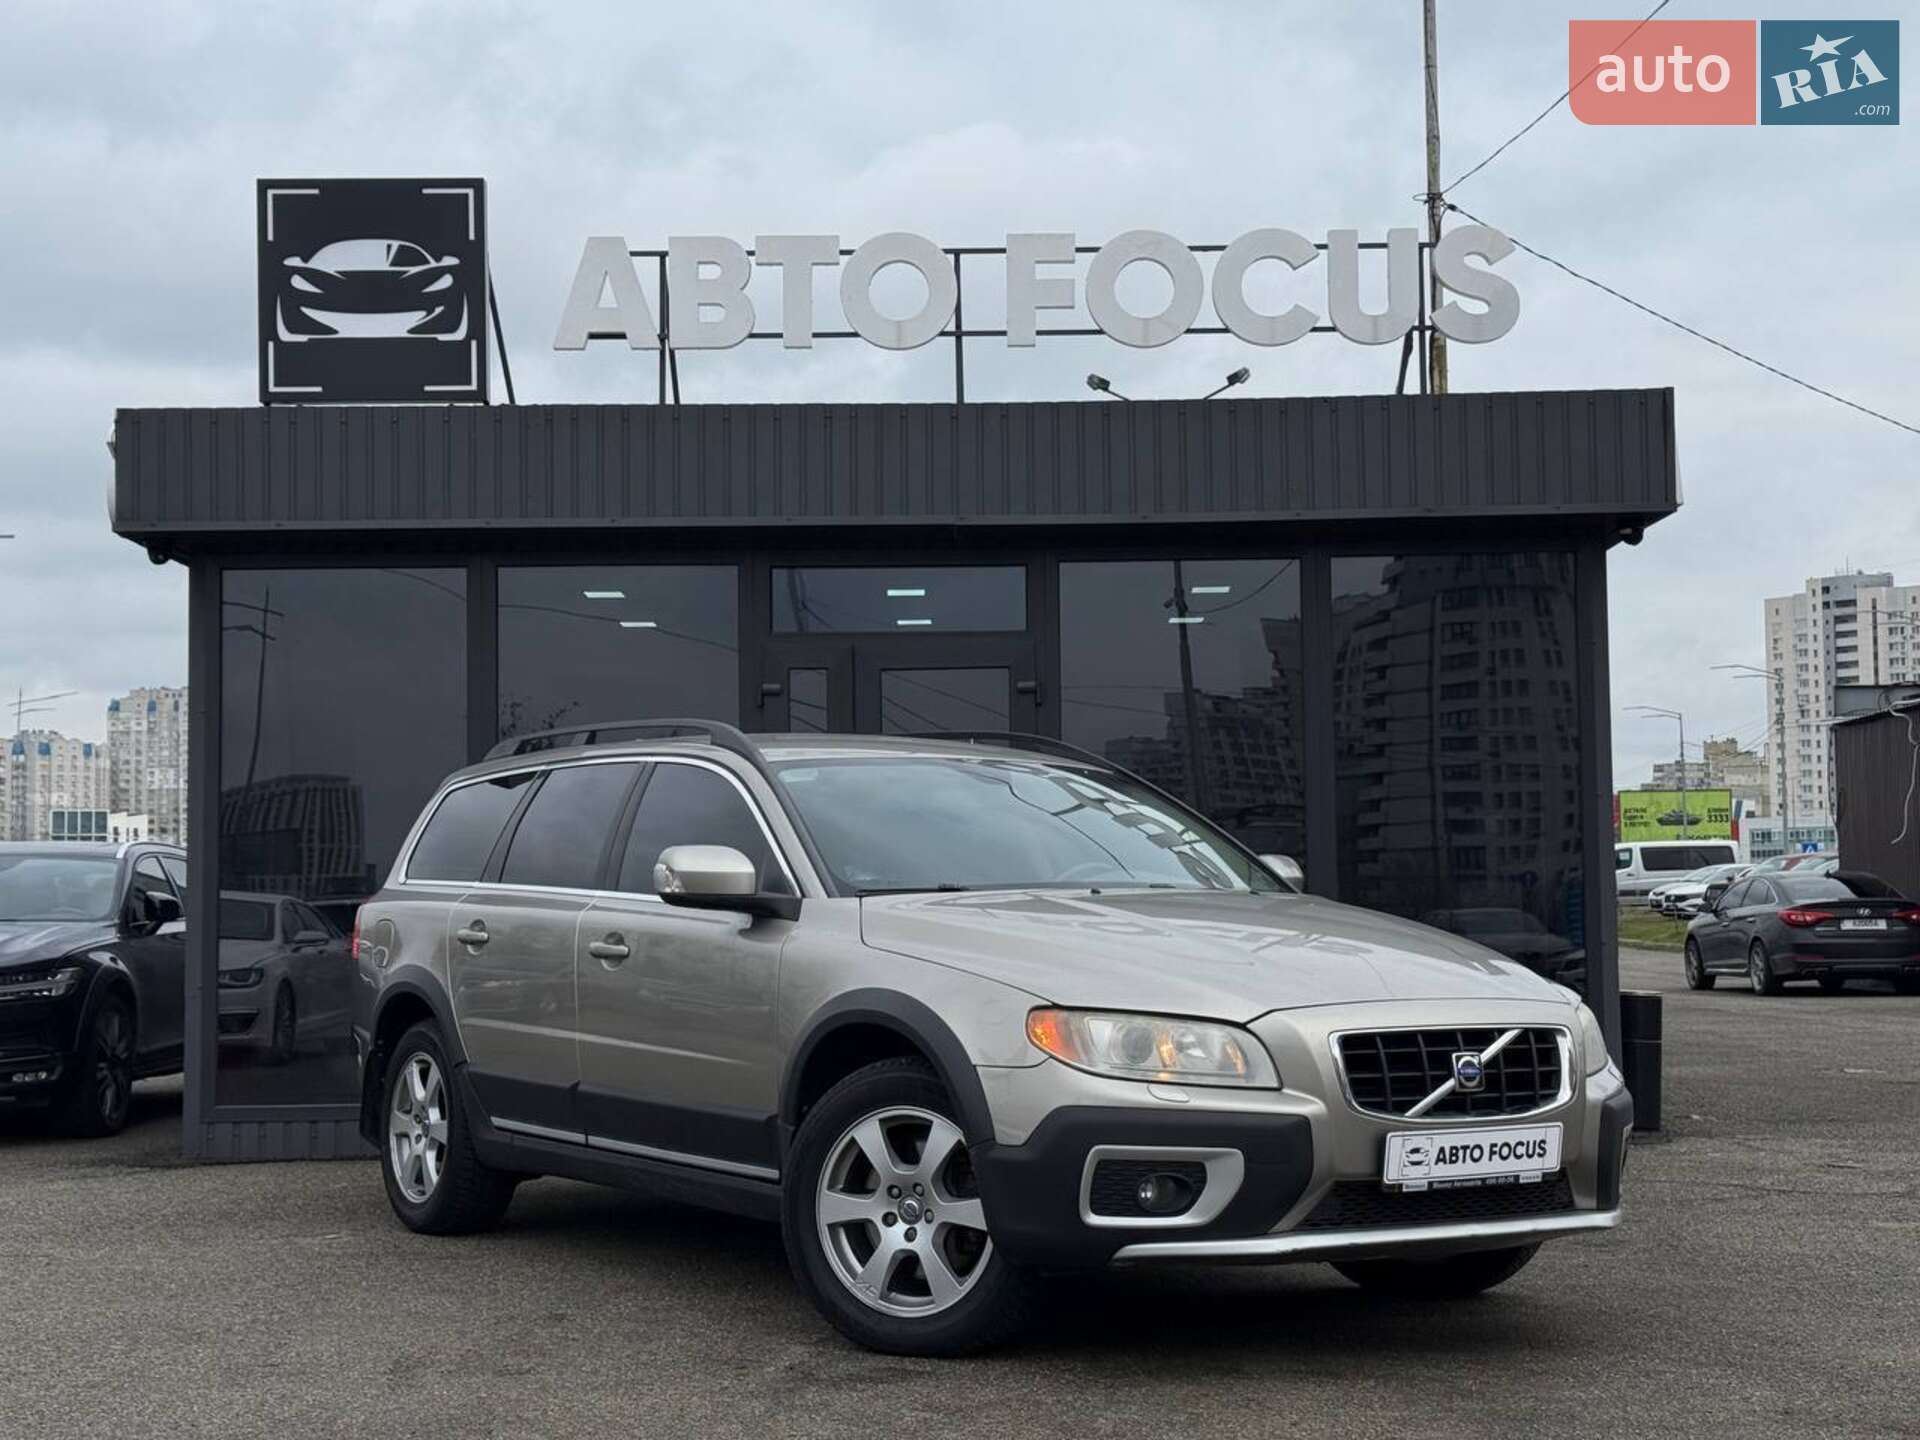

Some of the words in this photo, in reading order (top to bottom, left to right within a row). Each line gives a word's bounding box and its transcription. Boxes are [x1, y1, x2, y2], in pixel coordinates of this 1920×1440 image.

[553, 232, 958, 350] АВТО
[1006, 225, 1520, 348] FOCUS
[1434, 1144, 1484, 1165] АВТО
[1488, 1139, 1547, 1162] FOCUS
